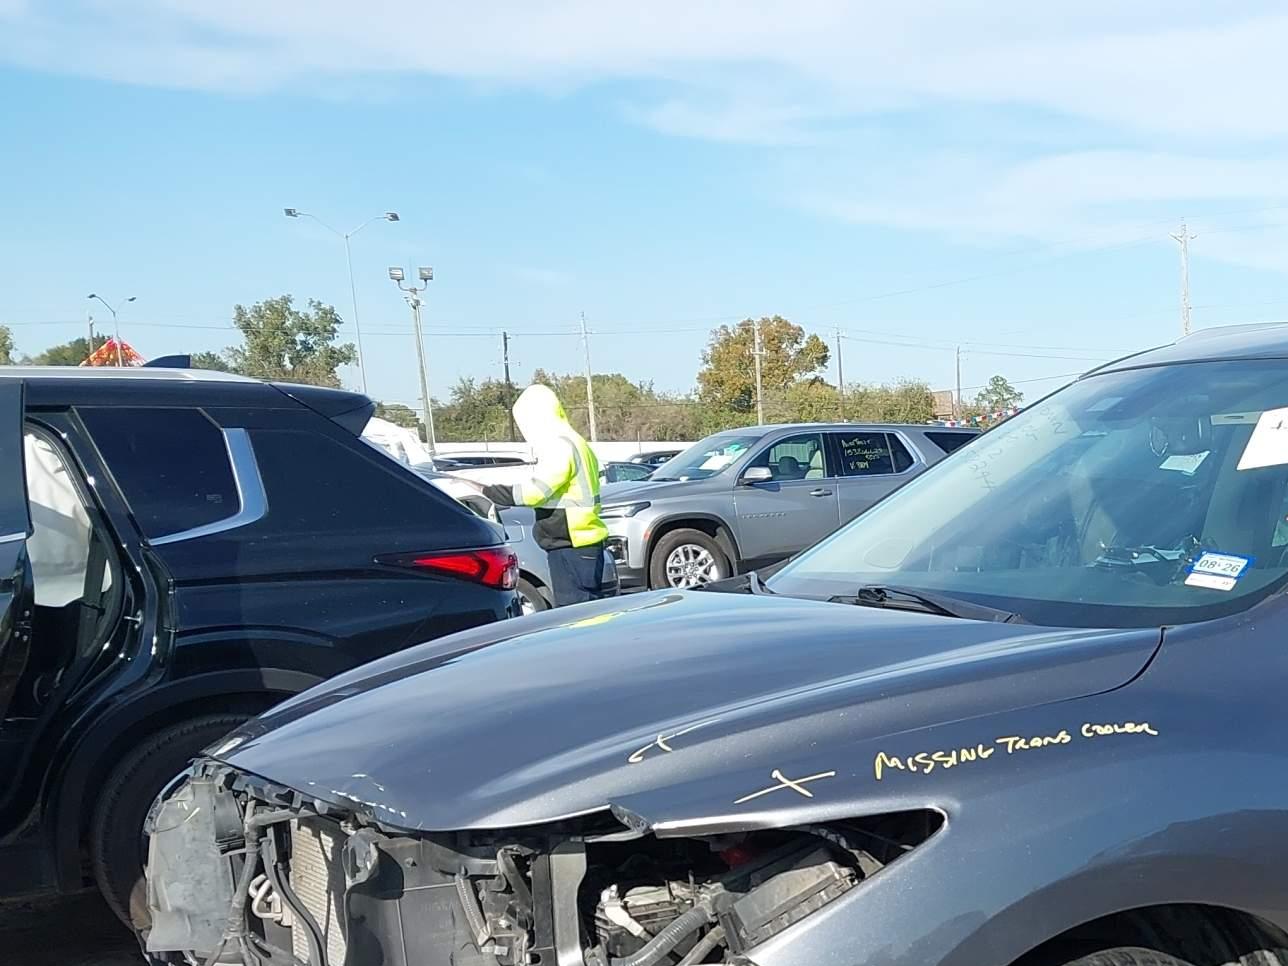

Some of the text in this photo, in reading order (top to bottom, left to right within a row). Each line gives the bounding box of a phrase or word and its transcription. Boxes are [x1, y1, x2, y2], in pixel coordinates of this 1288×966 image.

[1199, 559, 1241, 573] 08 26
[874, 743, 995, 781] MISSING
